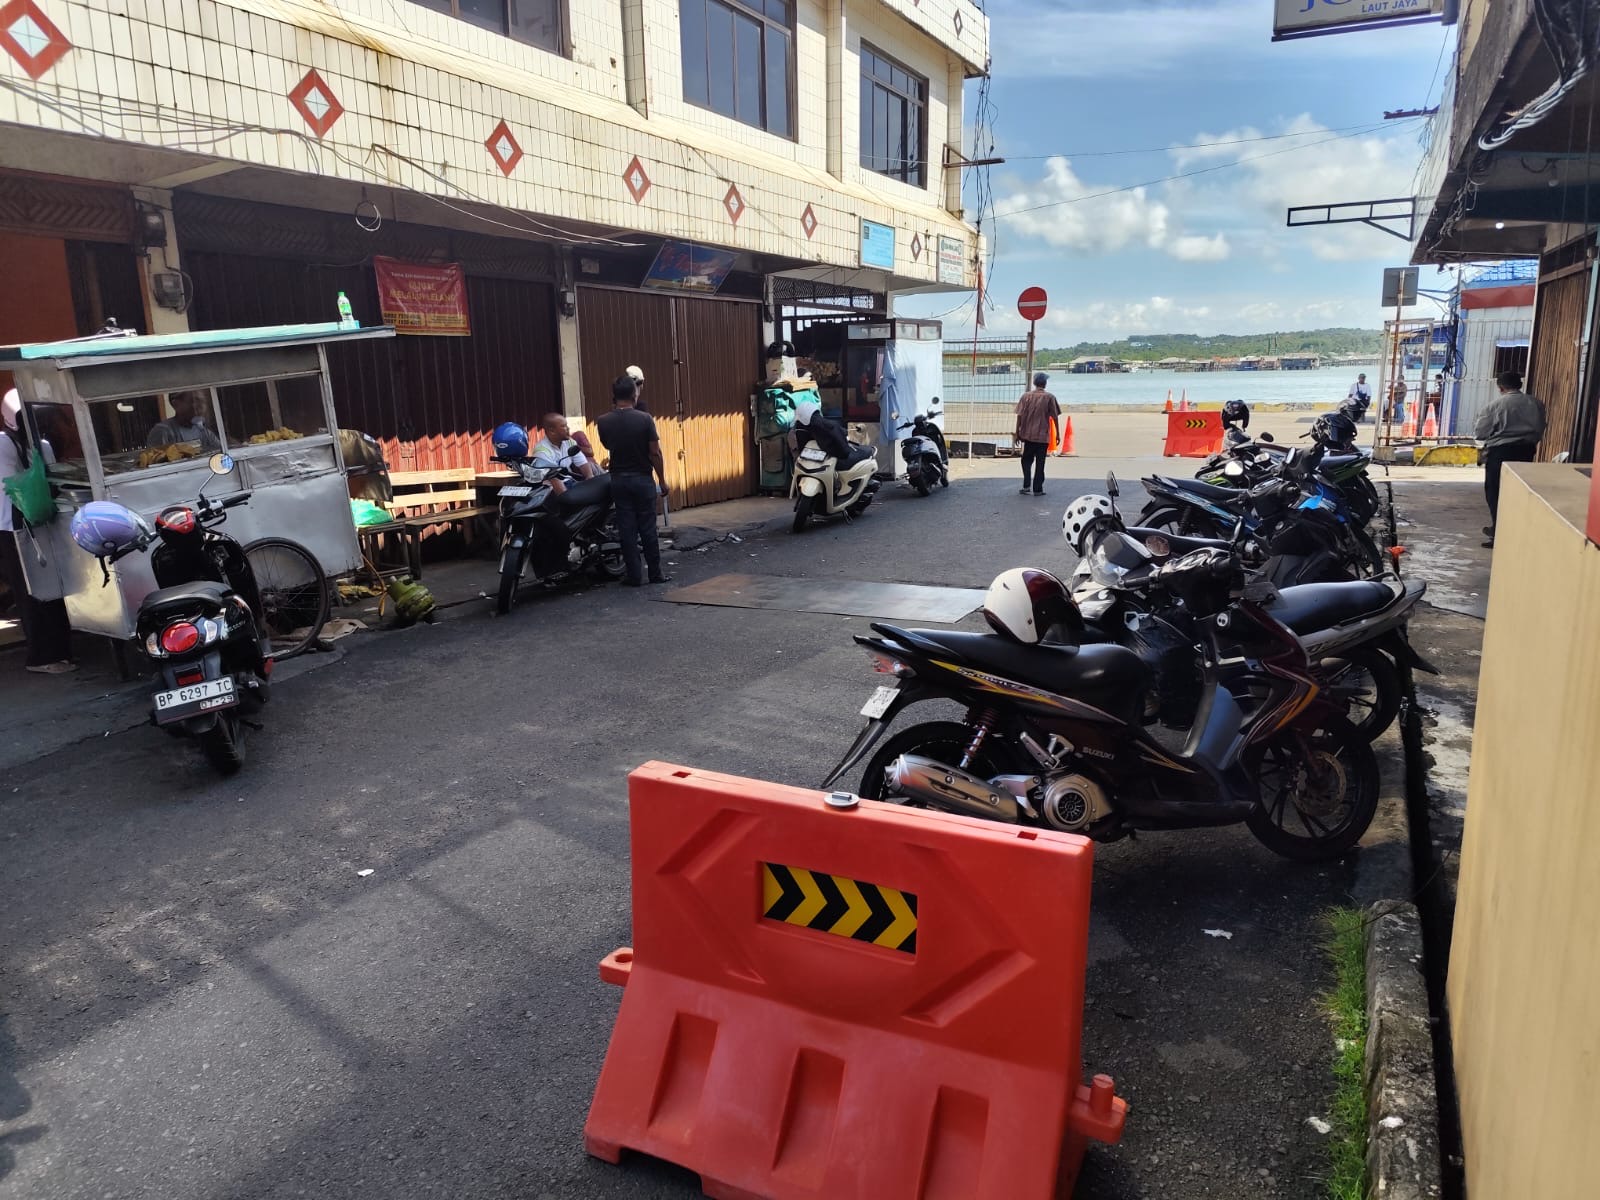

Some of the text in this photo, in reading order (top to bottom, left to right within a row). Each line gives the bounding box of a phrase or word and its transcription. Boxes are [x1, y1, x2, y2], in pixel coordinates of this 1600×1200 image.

[1361, 3, 1388, 13] LAUT
[1391, 0, 1418, 9] JAYA
[158, 680, 232, 707] BP 6297 TC
[1082, 746, 1115, 760] SUZUKI
